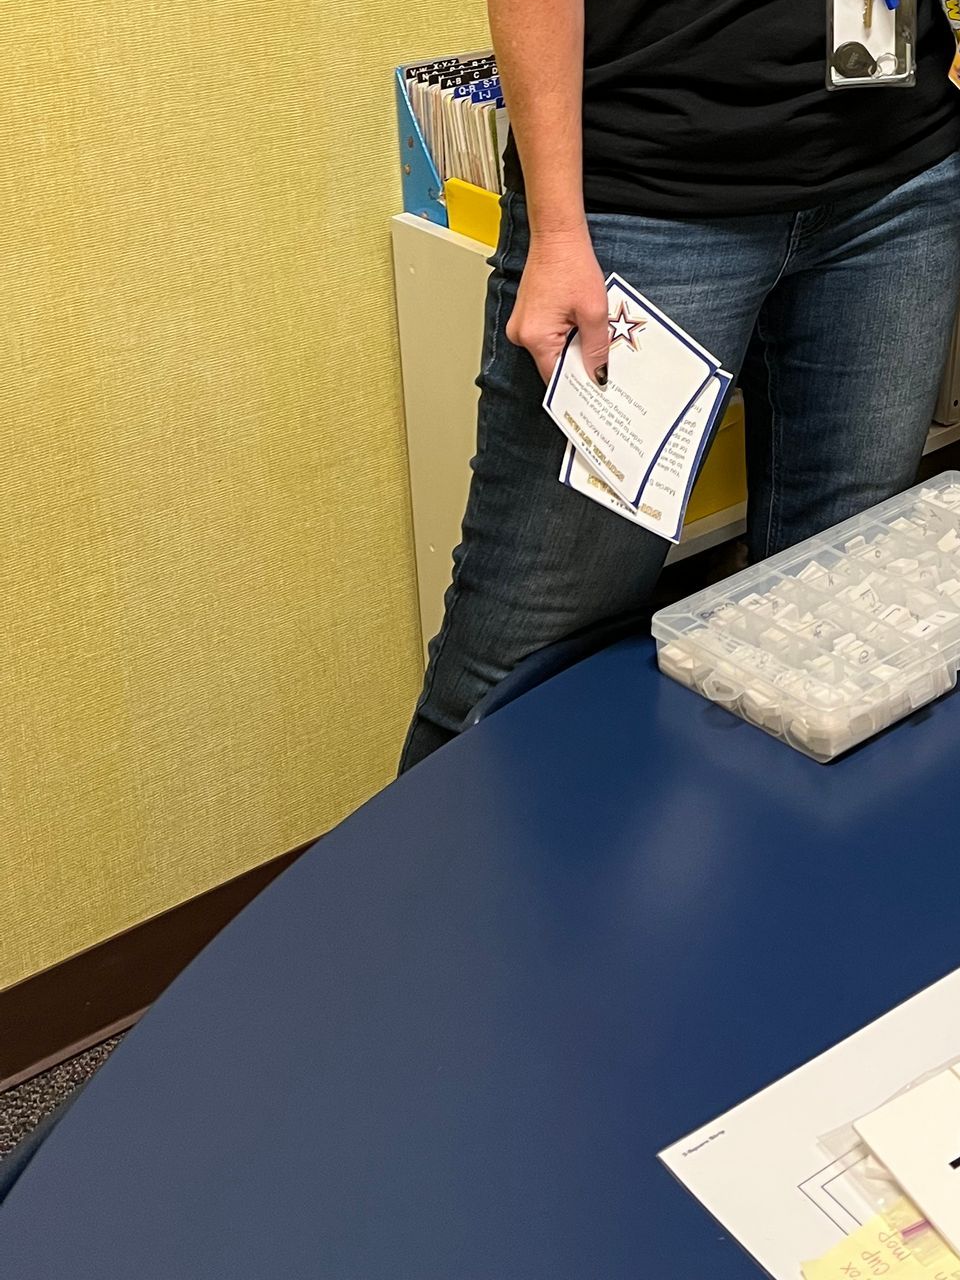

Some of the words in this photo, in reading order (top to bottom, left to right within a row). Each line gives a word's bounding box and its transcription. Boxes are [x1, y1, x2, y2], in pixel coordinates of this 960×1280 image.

[446, 78, 462, 87] A-B
[473, 71, 480, 79] C
[611, 404, 633, 424] Testing
[877, 1230, 912, 1262] mop
[860, 1250, 891, 1276] cup
